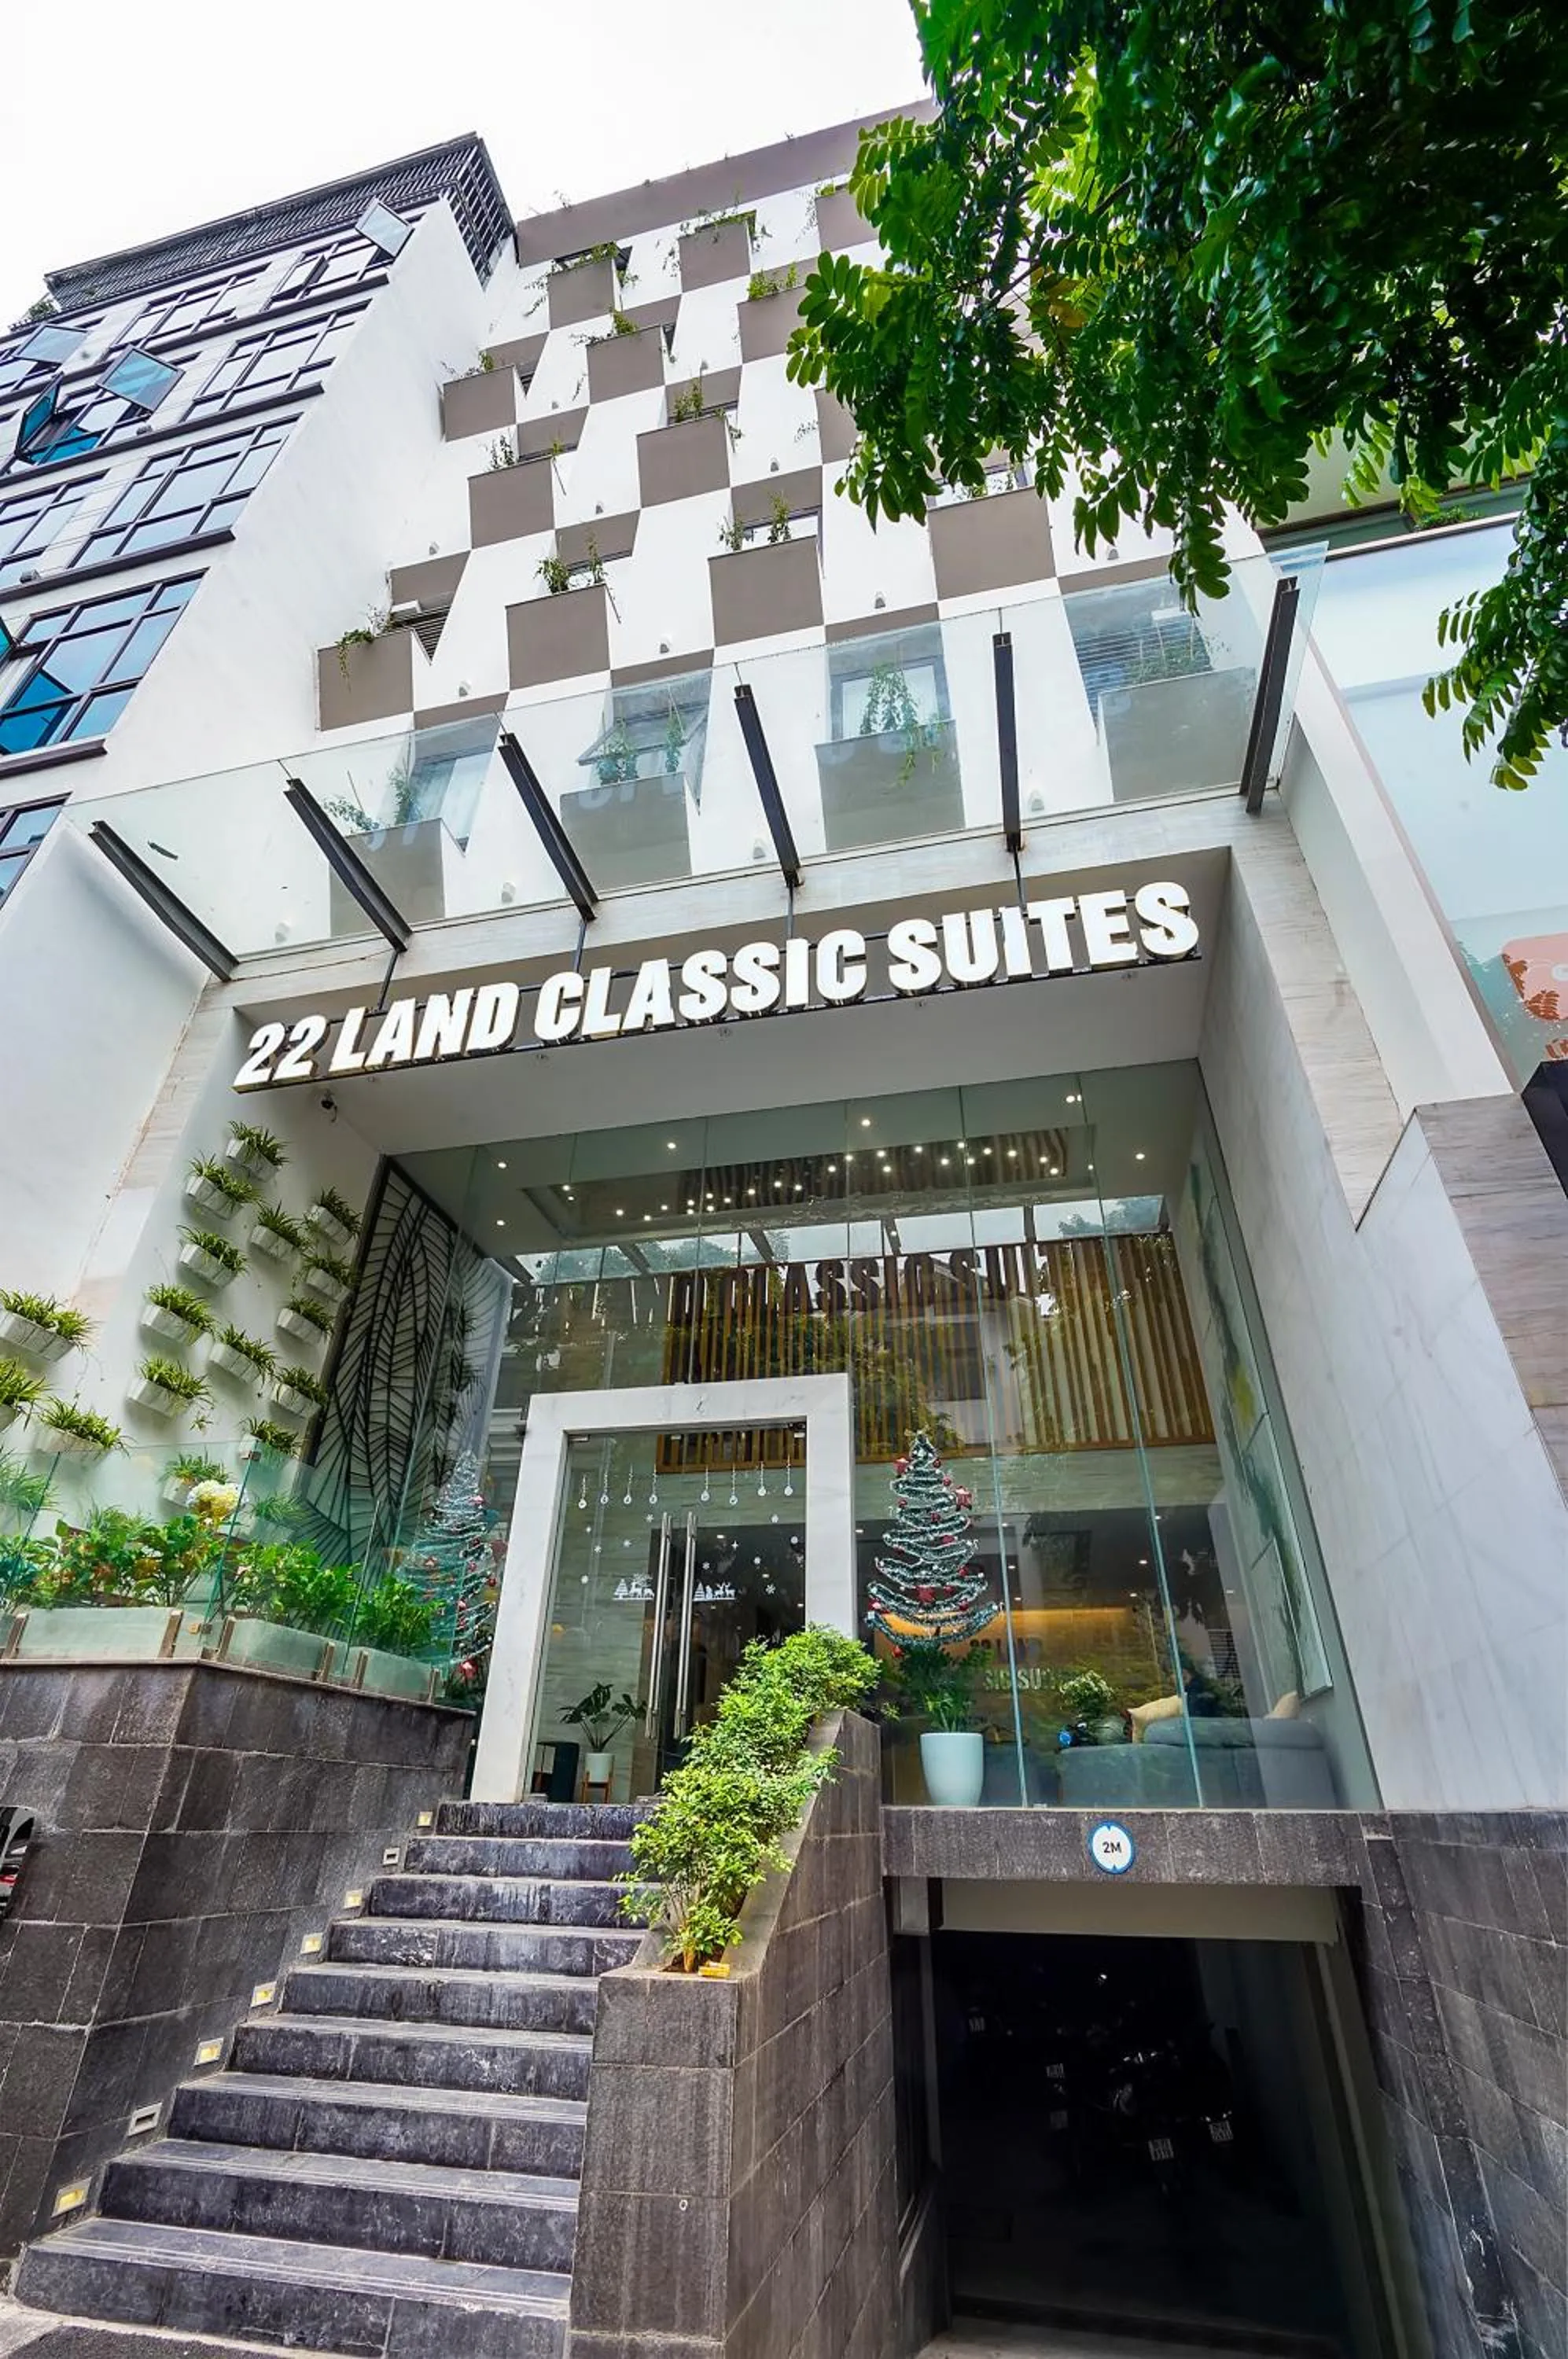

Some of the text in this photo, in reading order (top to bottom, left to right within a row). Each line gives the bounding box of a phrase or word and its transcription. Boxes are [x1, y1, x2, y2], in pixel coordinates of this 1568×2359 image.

[234, 881, 1200, 1088] 22 LAND CLASSIC SUITES
[1102, 1841, 1122, 1853] 2M
